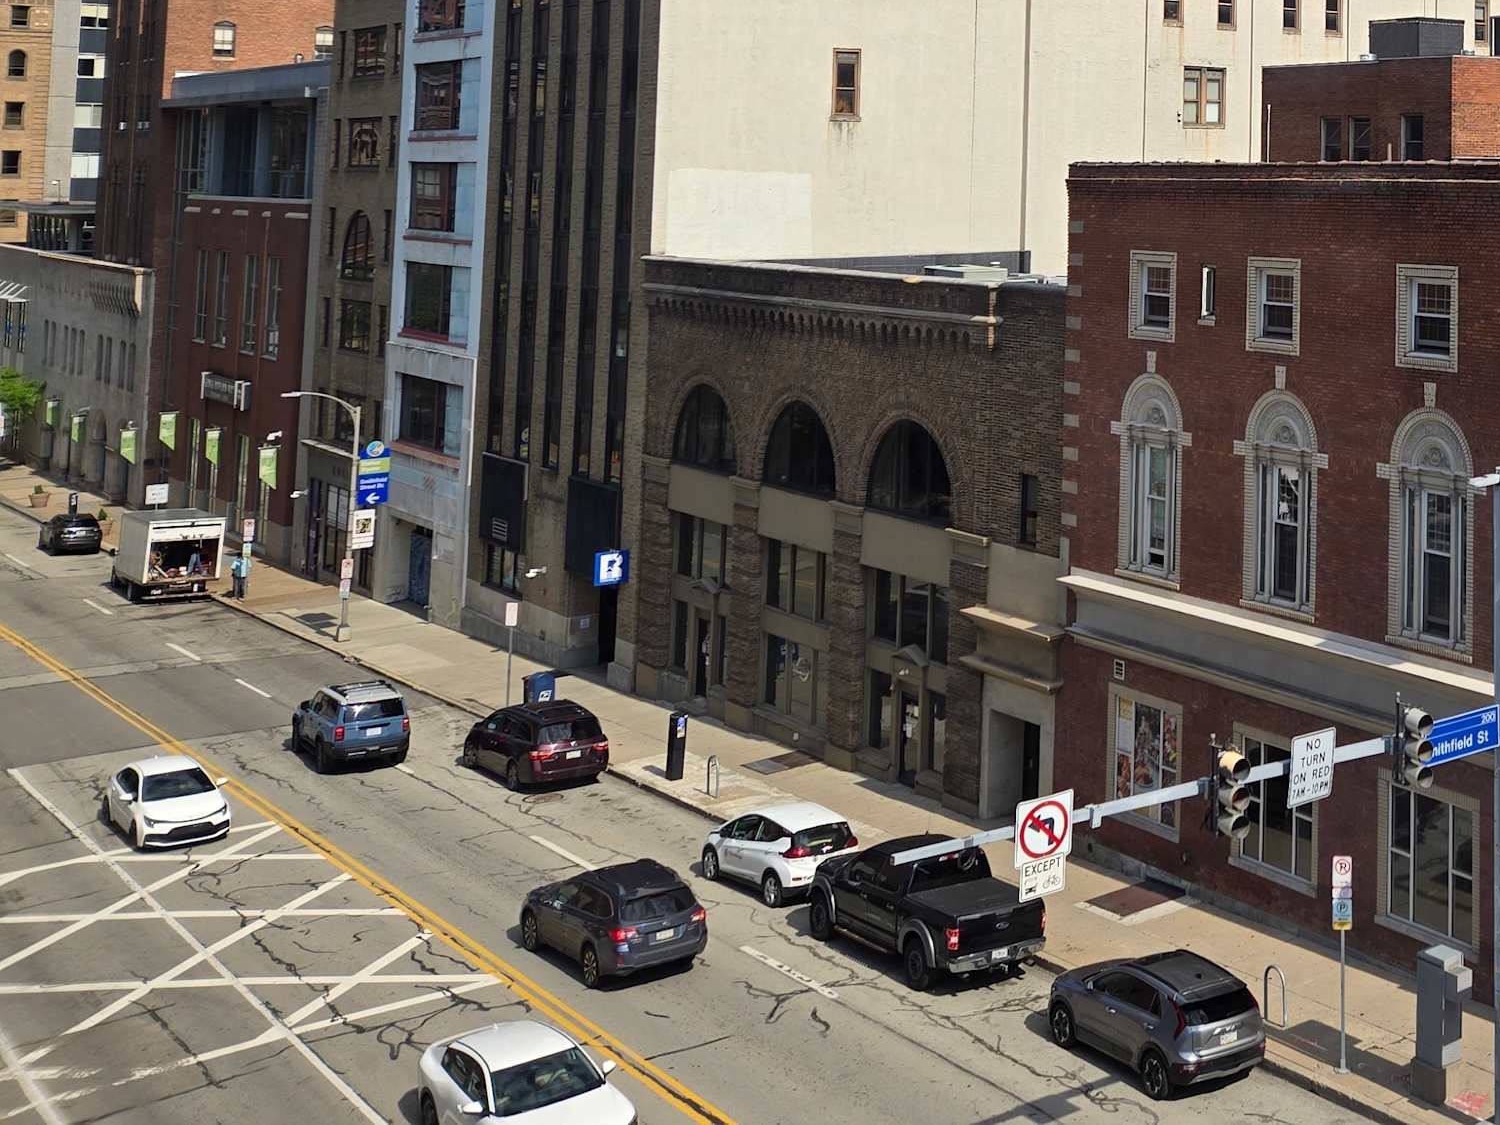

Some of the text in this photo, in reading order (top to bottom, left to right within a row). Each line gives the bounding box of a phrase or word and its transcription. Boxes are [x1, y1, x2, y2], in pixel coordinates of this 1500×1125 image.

[1481, 711, 1496, 724] 200
[1477, 730, 1489, 744] St
[1306, 738, 1321, 752] NO
[1300, 752, 1326, 768] TURN
[1293, 765, 1330, 785] ON RED
[1025, 857, 1061, 877] EXCEPT
